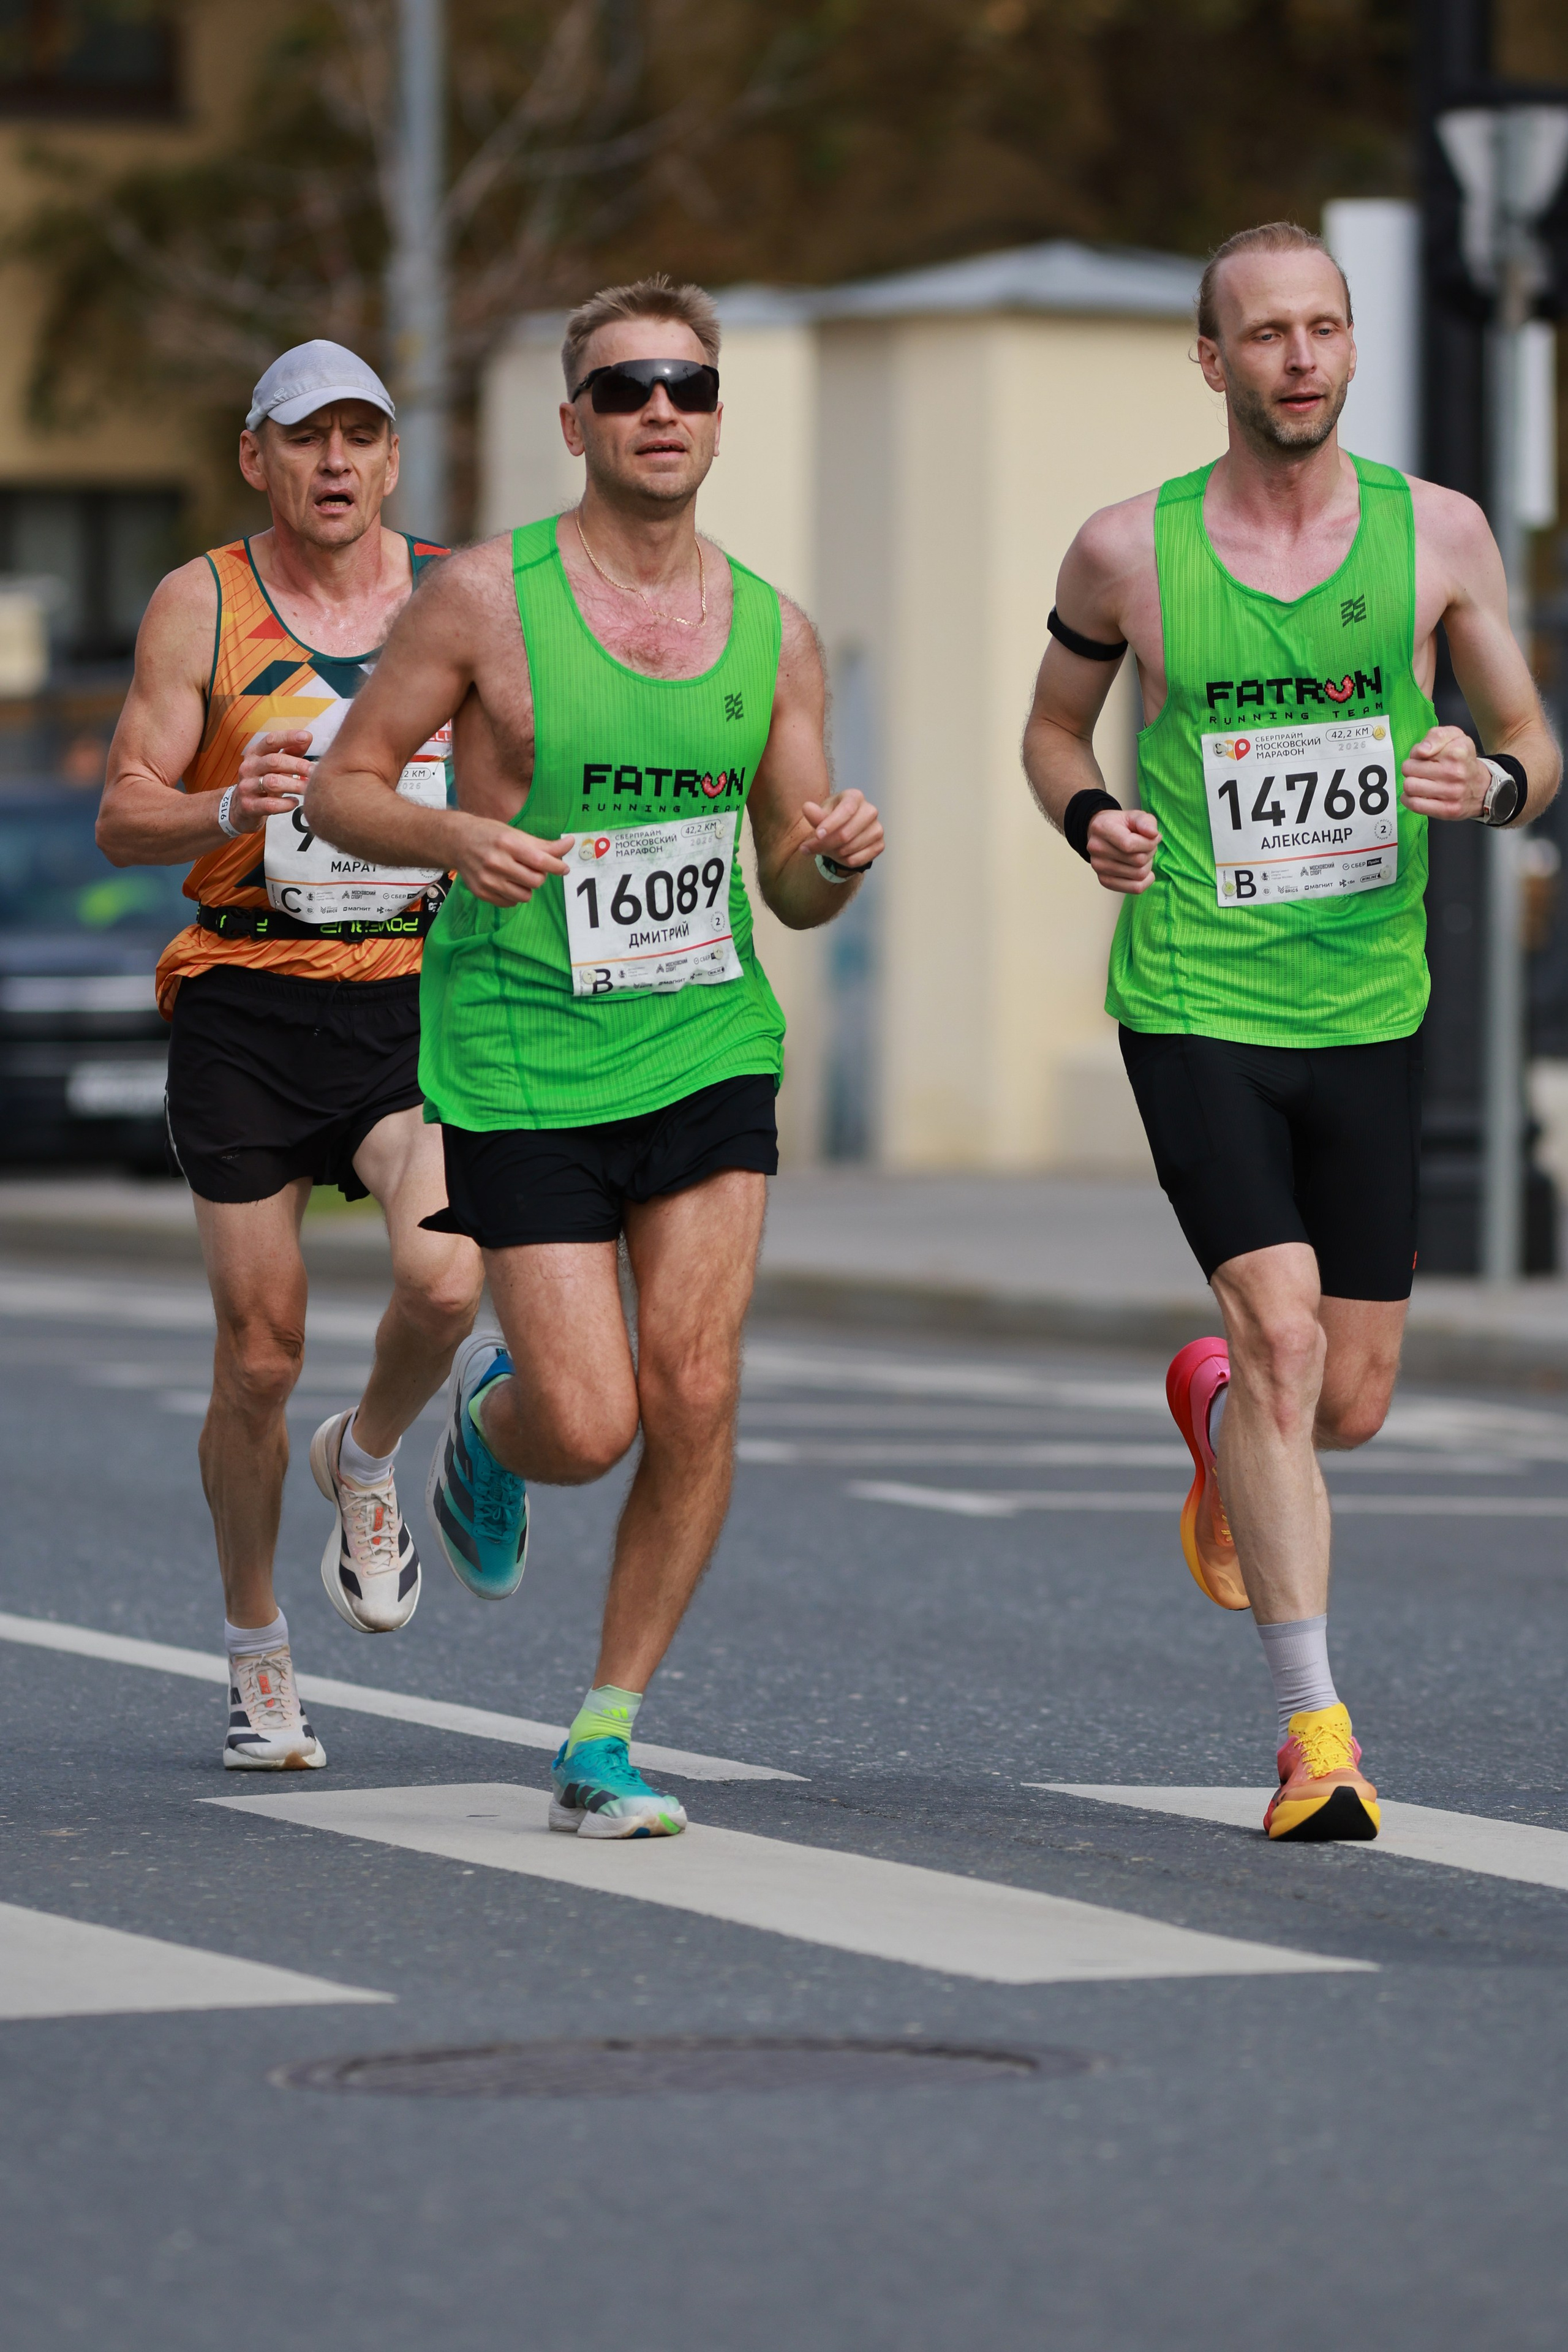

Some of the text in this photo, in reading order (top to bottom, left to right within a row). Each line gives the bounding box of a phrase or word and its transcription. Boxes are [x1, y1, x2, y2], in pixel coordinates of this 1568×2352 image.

[1206, 666, 1382, 709] FATRUN
[1210, 702, 1383, 725] RUNNING TEAM
[1255, 732, 1303, 742] СБЕРПРАЙМ
[1331, 727, 1369, 739] 42,2 КМ
[1256, 737, 1321, 751] МОСКОВСКИЙ
[1338, 741, 1366, 752] 2026
[1256, 748, 1305, 760] МАРАФОН
[582, 763, 745, 799] FATRUN
[1218, 764, 1390, 831] 14768
[221, 796, 230, 820] 9152
[582, 803, 741, 813] RUNNING TEAM
[615, 829, 662, 841] СБЕРПРАЙМ
[685, 821, 717, 835] 42,2 КМ
[1380, 825, 1387, 834] 2
[616, 835, 677, 849] МОСКОВСКИЙ
[1261, 827, 1353, 850] АЛЕКСАНДР
[616, 846, 663, 858] МАРАФОН
[1309, 862, 1335, 870] МОСКОВСКИЙ
[576, 857, 725, 929] 16089
[715, 917, 721, 926] 2
[628, 921, 690, 949] ДМИТРИЙ
